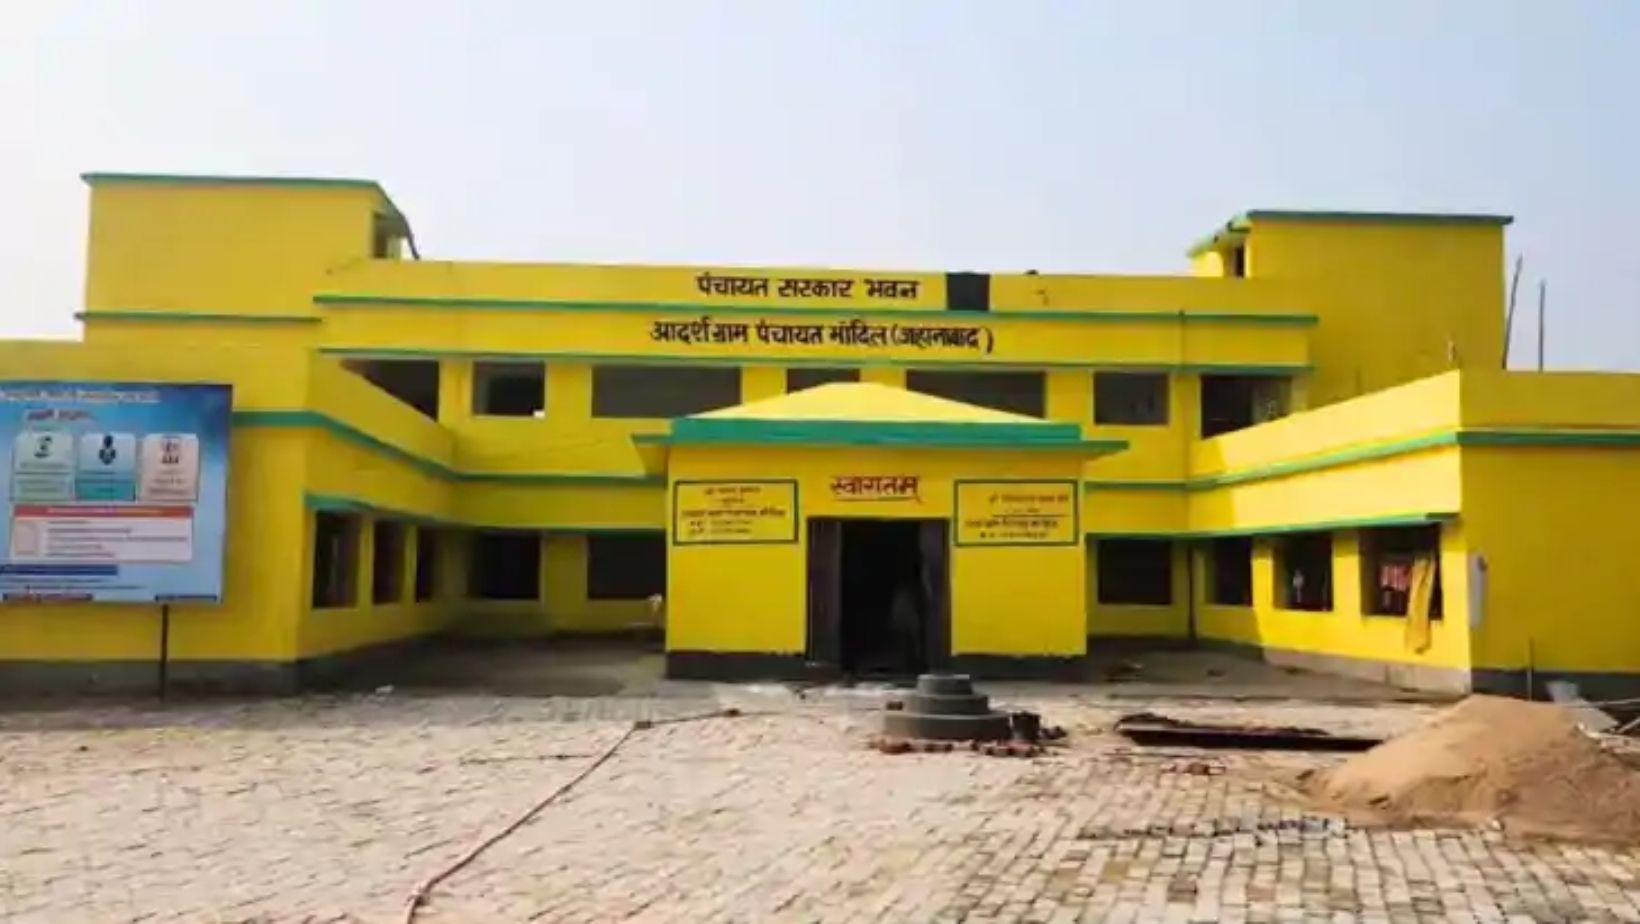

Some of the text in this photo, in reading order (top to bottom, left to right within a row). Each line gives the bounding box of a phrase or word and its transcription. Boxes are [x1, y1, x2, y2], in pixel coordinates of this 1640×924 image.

[697, 272, 919, 299] पंचायत सरकार भवन
[755, 318, 824, 345] पंचायत
